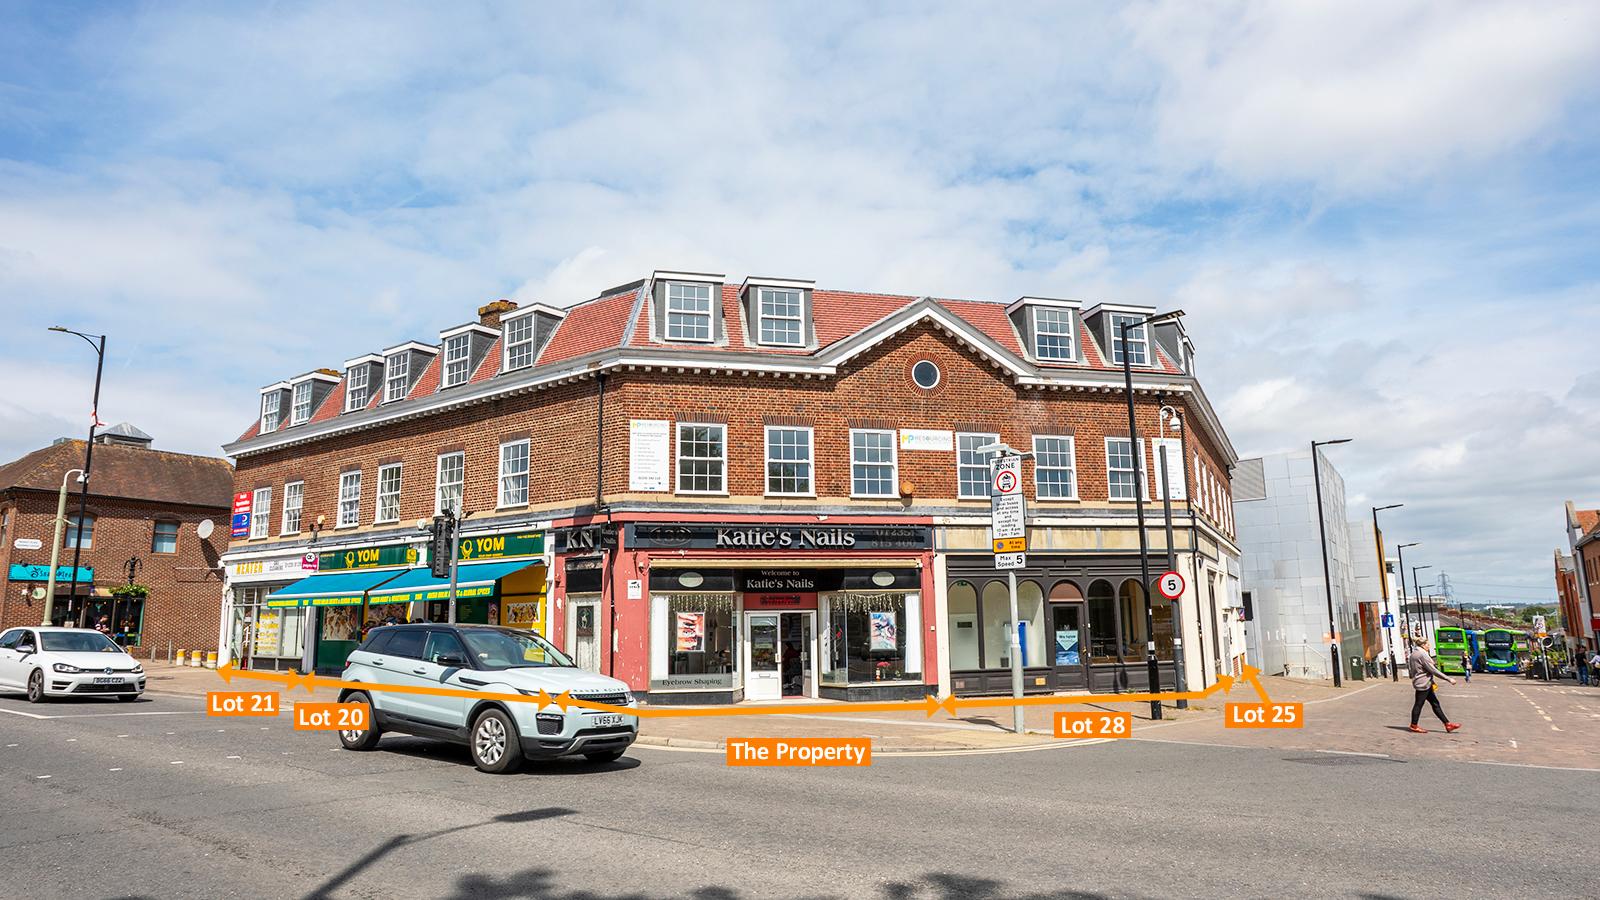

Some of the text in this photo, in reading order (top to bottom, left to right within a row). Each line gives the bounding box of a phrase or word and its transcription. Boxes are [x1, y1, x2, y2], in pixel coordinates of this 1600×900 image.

[995, 462, 1016, 470] ZONE
[566, 529, 594, 549] KN
[716, 527, 856, 547] Katie's Nails
[476, 536, 505, 552] YOM
[357, 549, 380, 563] YOM
[1016, 554, 1023, 565] 5
[746, 578, 814, 589] Katie's Nails
[1168, 580, 1176, 591] 5
[662, 679, 692, 687] Eyebrow
